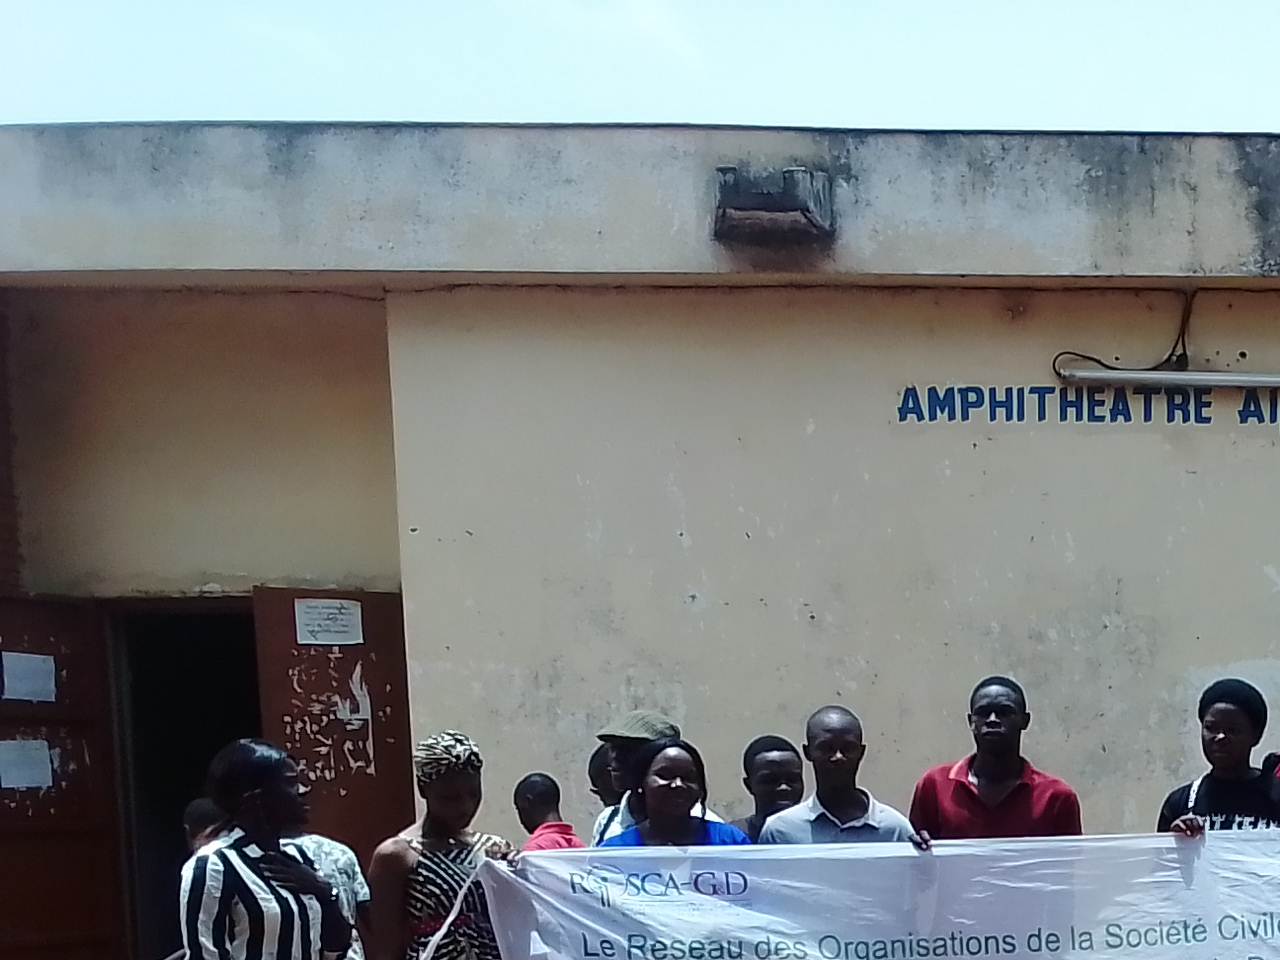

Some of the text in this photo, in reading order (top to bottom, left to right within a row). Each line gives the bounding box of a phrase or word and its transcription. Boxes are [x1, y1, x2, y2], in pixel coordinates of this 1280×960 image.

[897, 385, 1213, 424] AMPHITHEATRE
[581, 931, 617, 958] Le
[754, 935, 808, 960] des
[1026, 927, 1061, 953] de
[1070, 925, 1094, 951] la
[1104, 917, 1208, 949] Société
